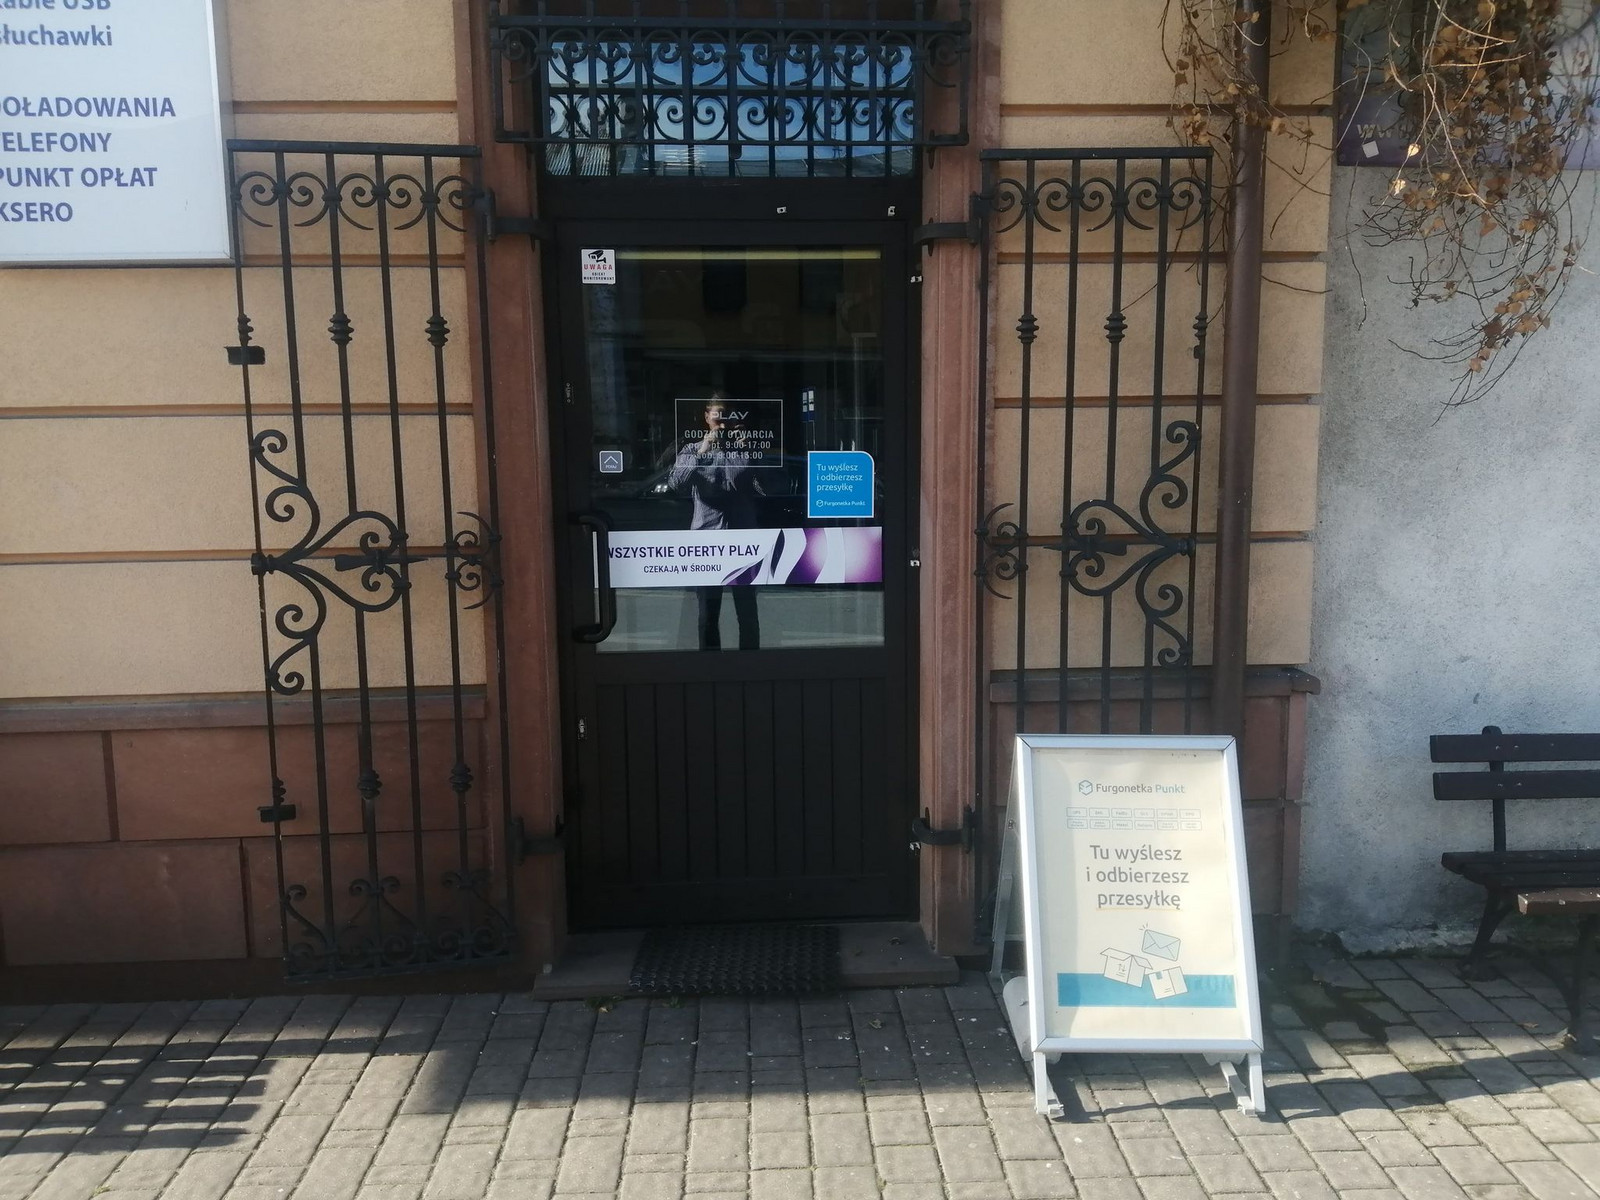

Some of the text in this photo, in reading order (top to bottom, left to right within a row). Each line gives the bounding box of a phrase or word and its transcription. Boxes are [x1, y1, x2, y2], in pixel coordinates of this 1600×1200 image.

[0, 24, 112, 46] łuchawki
[0, 97, 176, 117] OŁADOWANIA
[0, 132, 112, 152] ELEFONY
[80, 167, 158, 187] OPŁAT
[711, 411, 749, 420] PLAY
[727, 429, 774, 439] OTWARCIA
[725, 441, 771, 449] 9:00-17:00
[816, 462, 859, 472] Tu wyślesz
[820, 473, 863, 481] odbierzesz
[816, 483, 854, 492] przesyłkę
[678, 545, 725, 558] OFERTY
[729, 544, 760, 556] PLAY
[643, 562, 722, 574] CZEKAJĄ W ŚRODKU
[1096, 783, 1185, 794] Furgonetka Punkt
[1089, 843, 1182, 864] Tu wyślesz
[1086, 866, 1190, 884] i odbierzesz
[1097, 889, 1182, 910] przesyłkę
